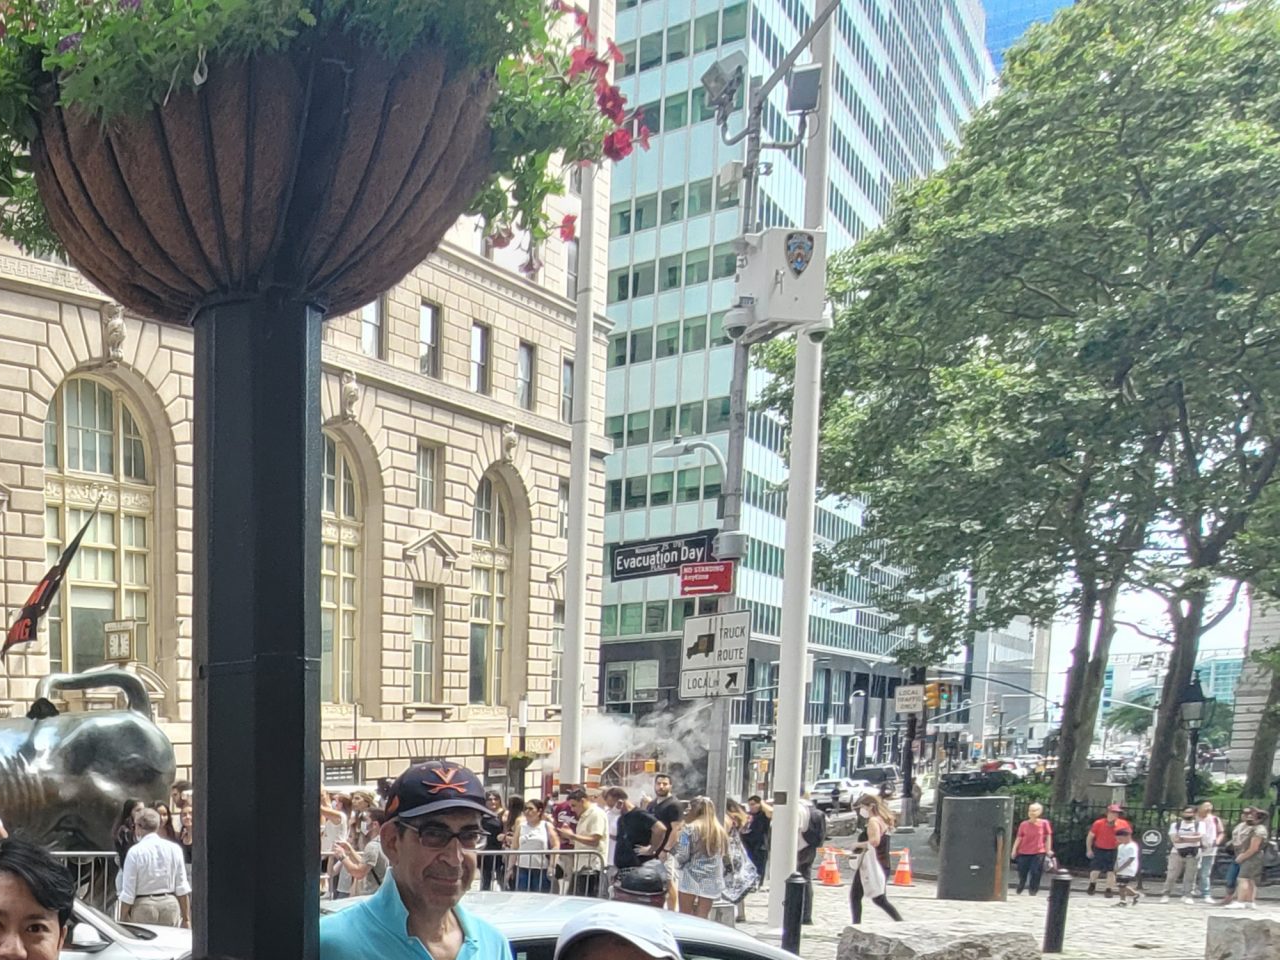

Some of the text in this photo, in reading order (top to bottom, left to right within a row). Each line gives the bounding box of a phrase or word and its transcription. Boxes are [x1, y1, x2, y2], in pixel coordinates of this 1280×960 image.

[616, 546, 705, 570] Evacuation Day
[694, 565, 725, 573] STANDING
[683, 573, 709, 581] Anytime
[719, 626, 746, 640] TRUCK
[717, 648, 745, 661] ROUTE
